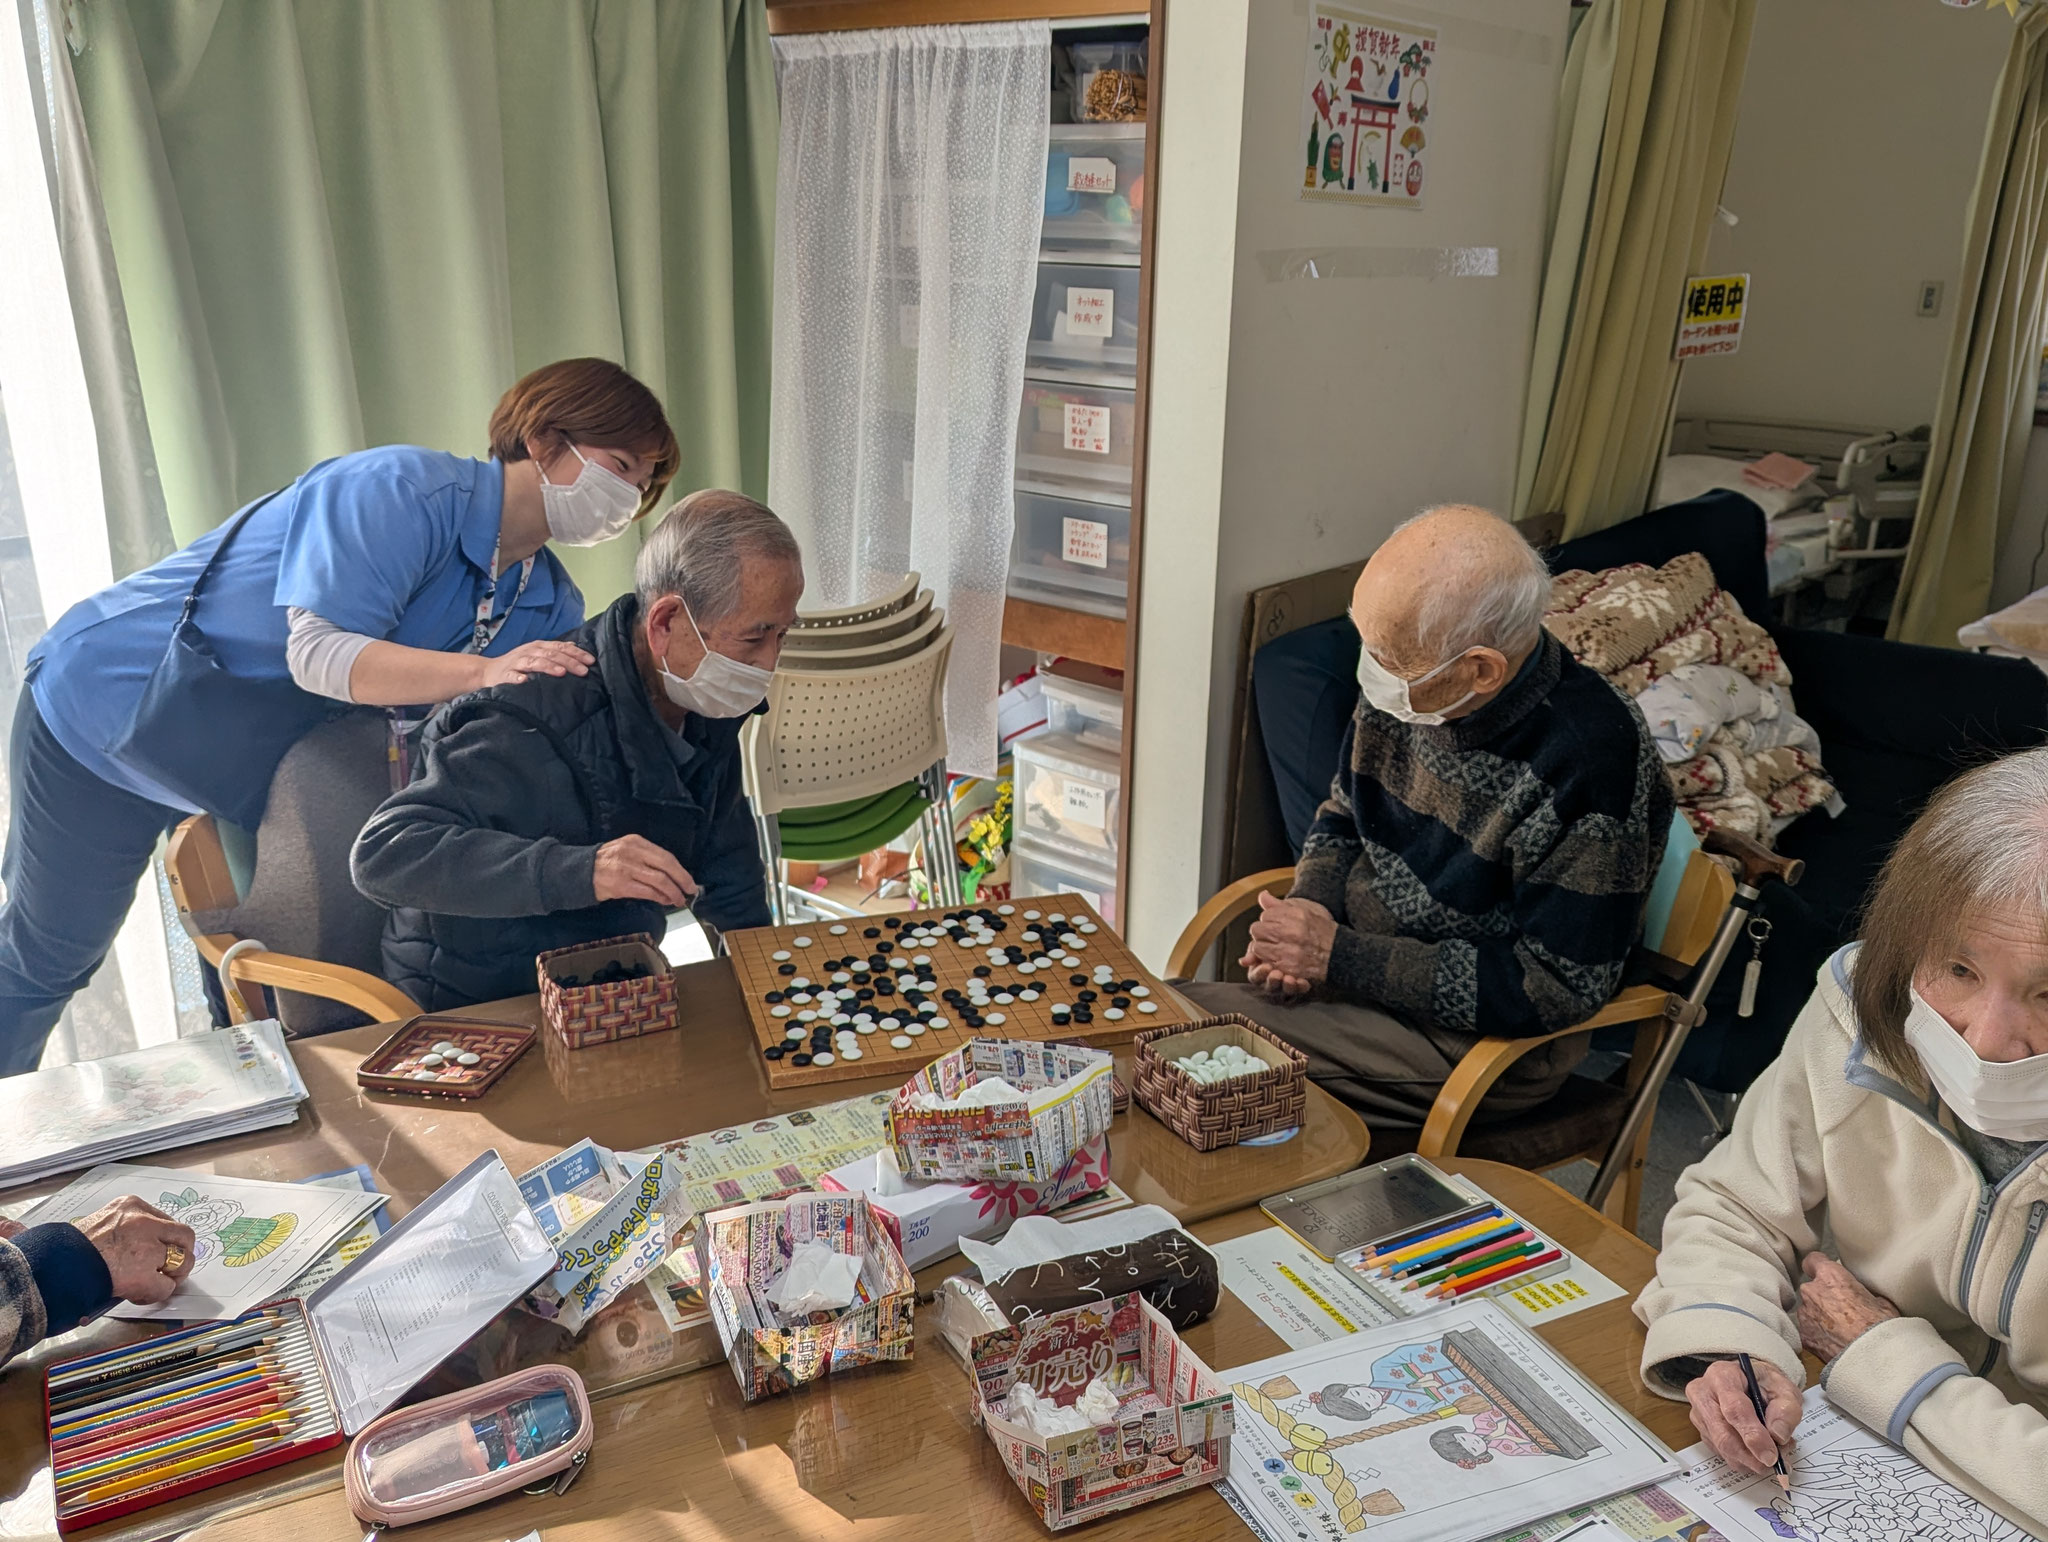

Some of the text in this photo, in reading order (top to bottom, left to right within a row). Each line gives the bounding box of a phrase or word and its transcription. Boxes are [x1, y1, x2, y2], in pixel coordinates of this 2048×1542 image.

[1355, 26, 1401, 59] 謹賀新年
[1686, 281, 1744, 318] 使用中
[908, 1226, 930, 1243] 200
[1048, 1334, 1079, 1351] 新春
[1016, 1342, 1117, 1394] 初売り
[1157, 1434, 1174, 1445] 239
[1099, 1451, 1117, 1466] 722
[1266, 1489, 1303, 1530] 美しいぬり絵
